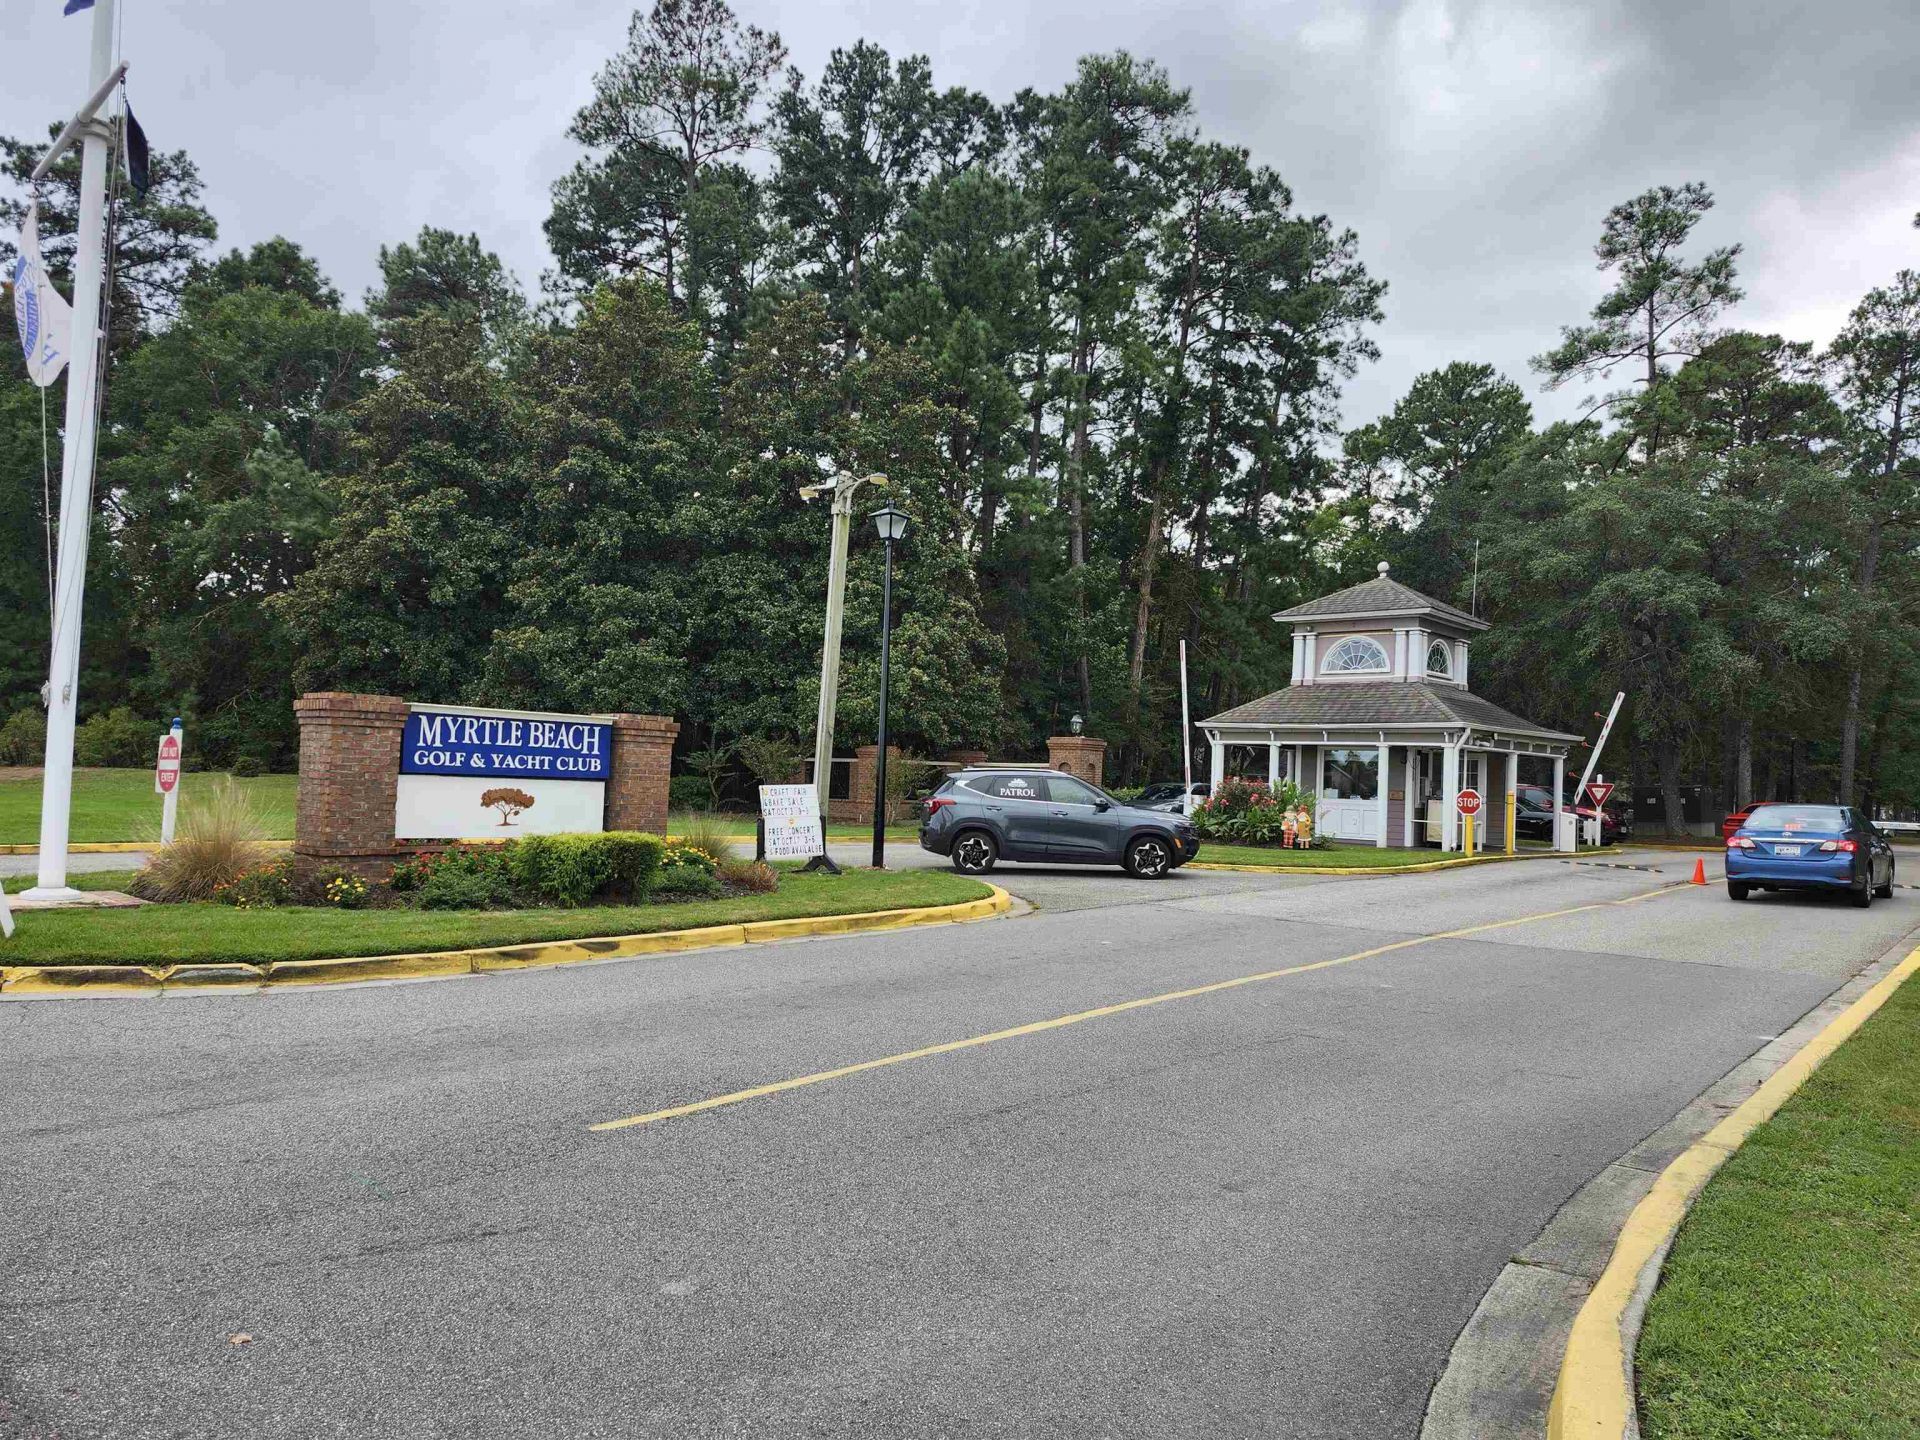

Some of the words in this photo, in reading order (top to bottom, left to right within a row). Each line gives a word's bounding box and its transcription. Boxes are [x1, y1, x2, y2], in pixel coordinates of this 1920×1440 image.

[417, 715, 522, 747] MYRTLE
[528, 722, 601, 755] BEACH
[414, 750, 466, 767] GOLF
[470, 753, 486, 768] &
[491, 753, 553, 770] YACHT
[556, 756, 602, 772] CLUB
[161, 772, 175, 782] ENTER
[770, 788, 789, 796] CRAFT
[1000, 787, 1036, 797] PATROL
[1457, 797, 1480, 808] STOP
[769, 827, 784, 836] FREE
[788, 826, 815, 835] CONCERT
[775, 847, 790, 856] FOOD
